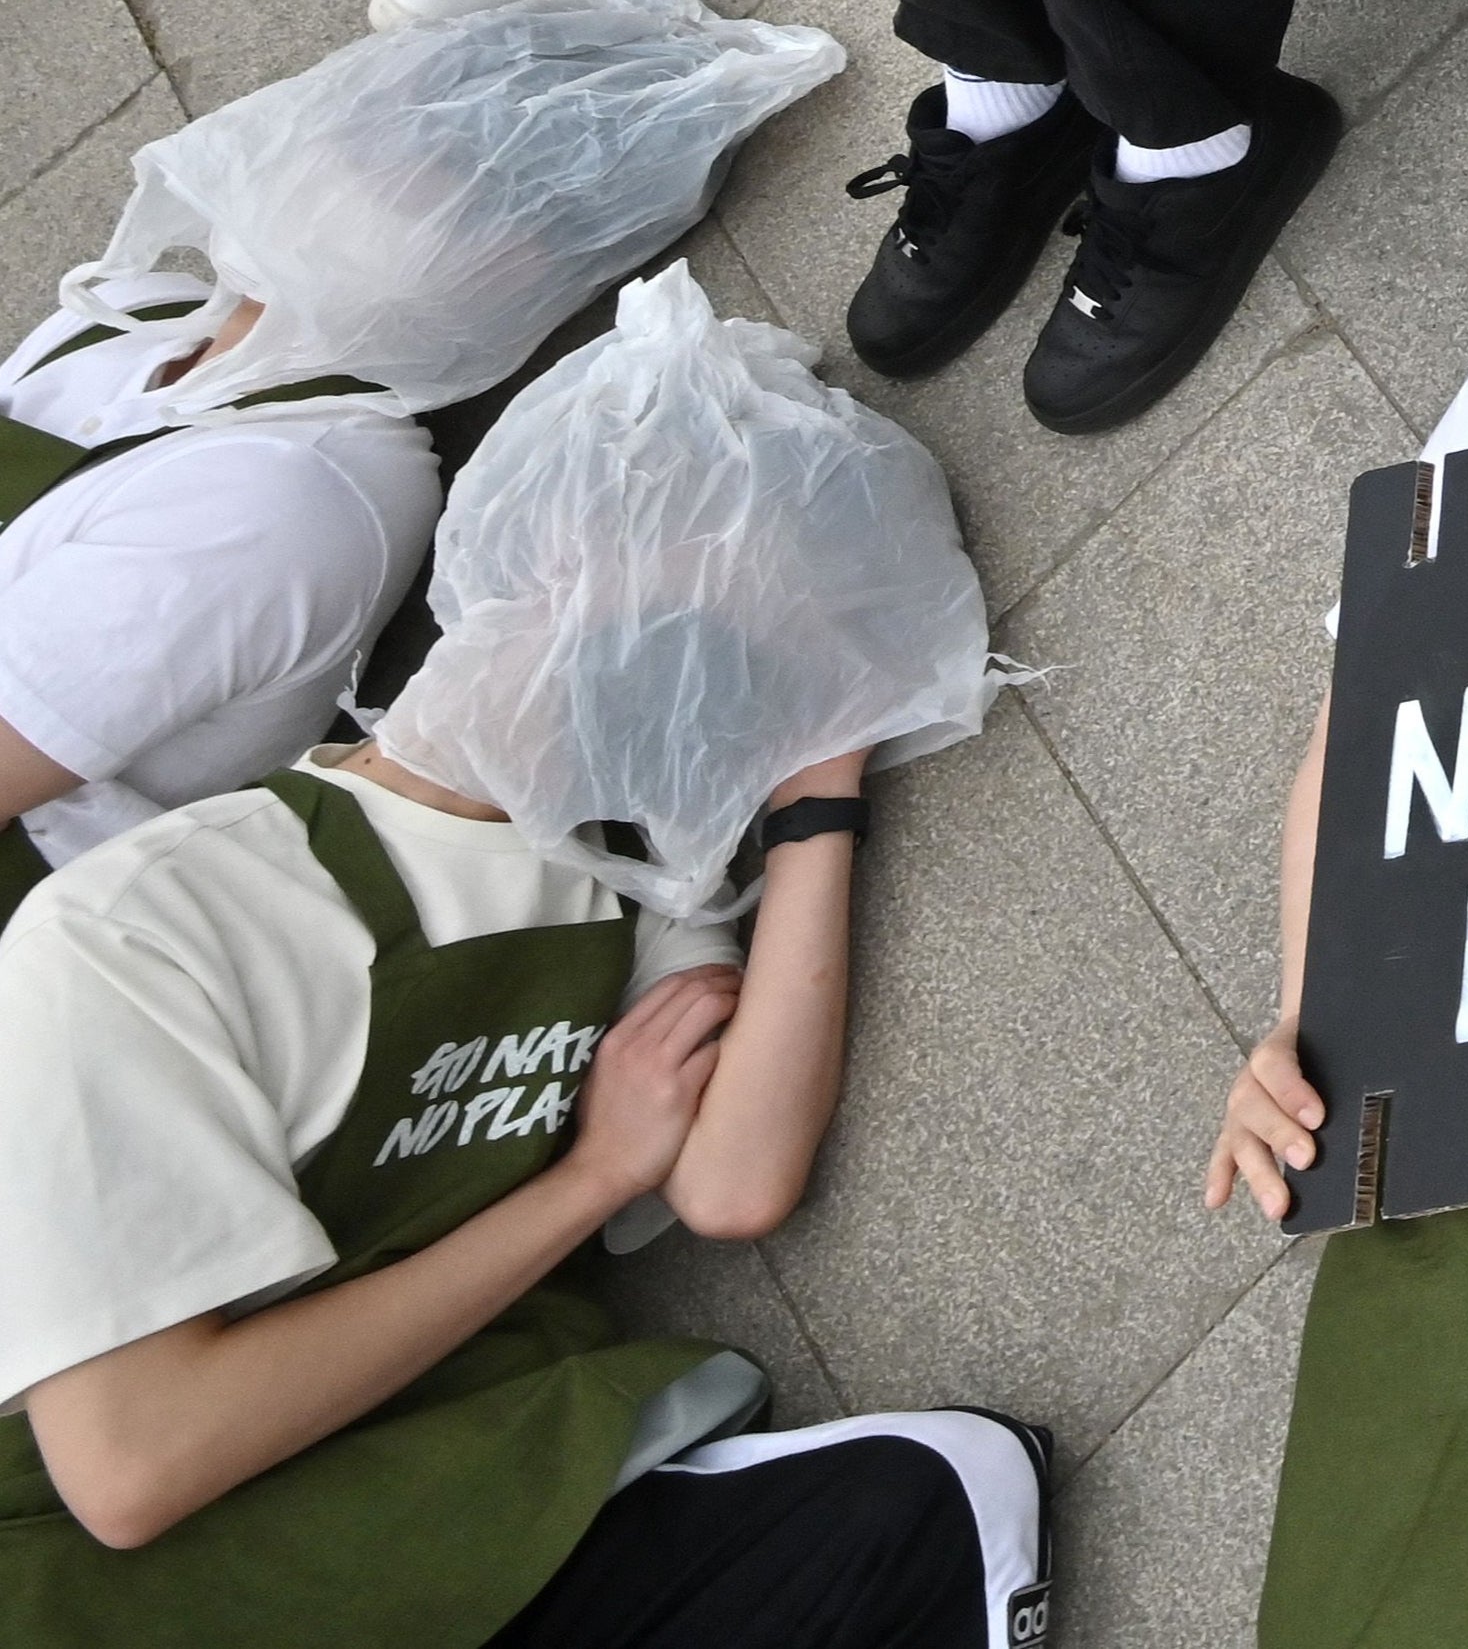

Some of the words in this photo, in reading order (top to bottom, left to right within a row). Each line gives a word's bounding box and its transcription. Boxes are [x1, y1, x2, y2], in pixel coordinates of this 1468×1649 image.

[410, 1035, 489, 1100] GO
[479, 1020, 607, 1084] NAK
[372, 1100, 460, 1168] NO
